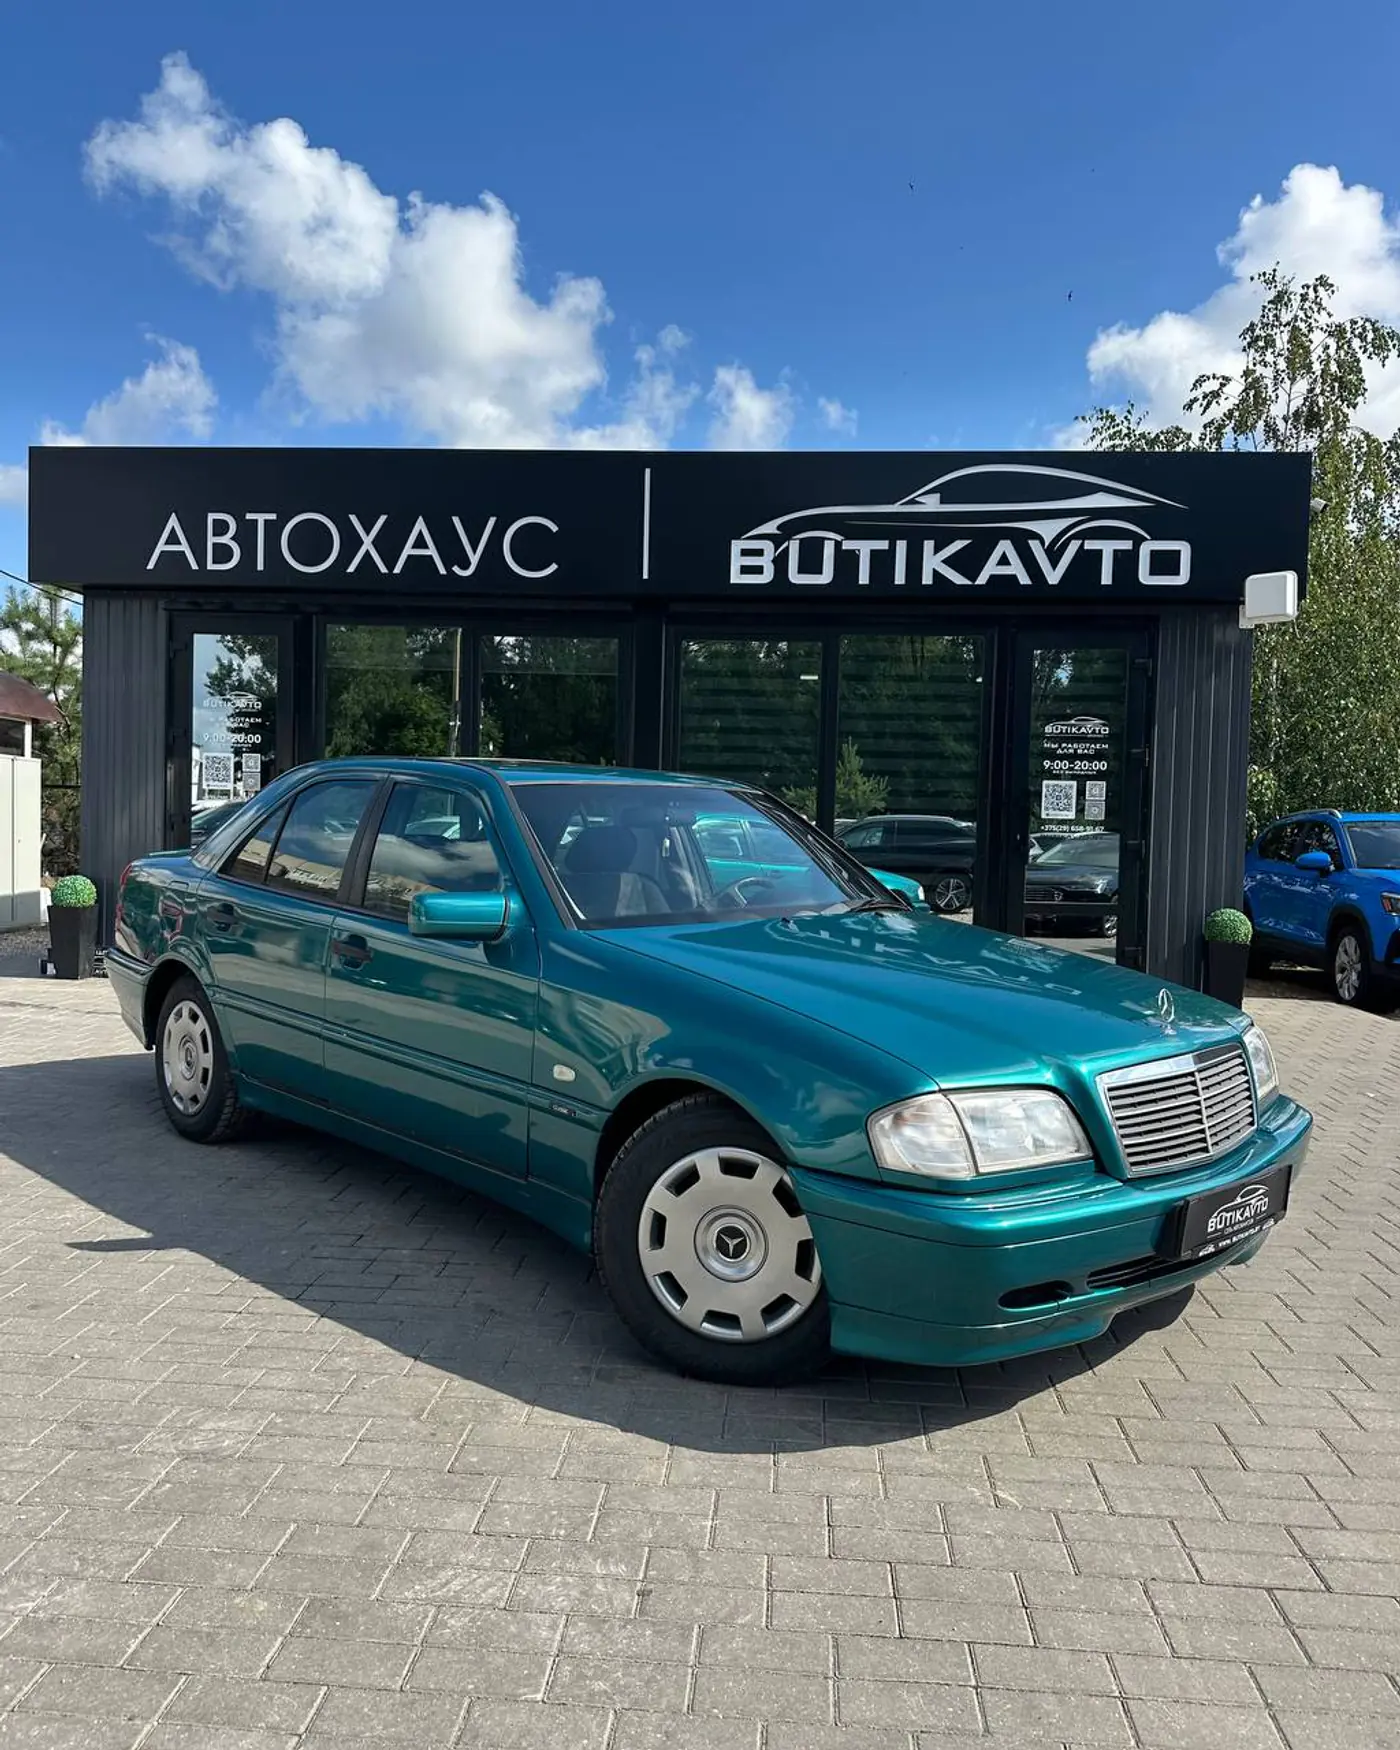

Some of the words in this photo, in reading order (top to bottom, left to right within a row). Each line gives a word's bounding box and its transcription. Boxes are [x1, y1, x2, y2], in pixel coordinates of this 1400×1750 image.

[145, 511, 559, 578] АВТОХАУС
[730, 538, 1192, 586] BUTIKAVTO
[1044, 725, 1109, 734] BUTIKAVTO
[1043, 760, 1108, 771] 9:00-20:00
[1207, 1196, 1269, 1233] BUTIKAVTO
